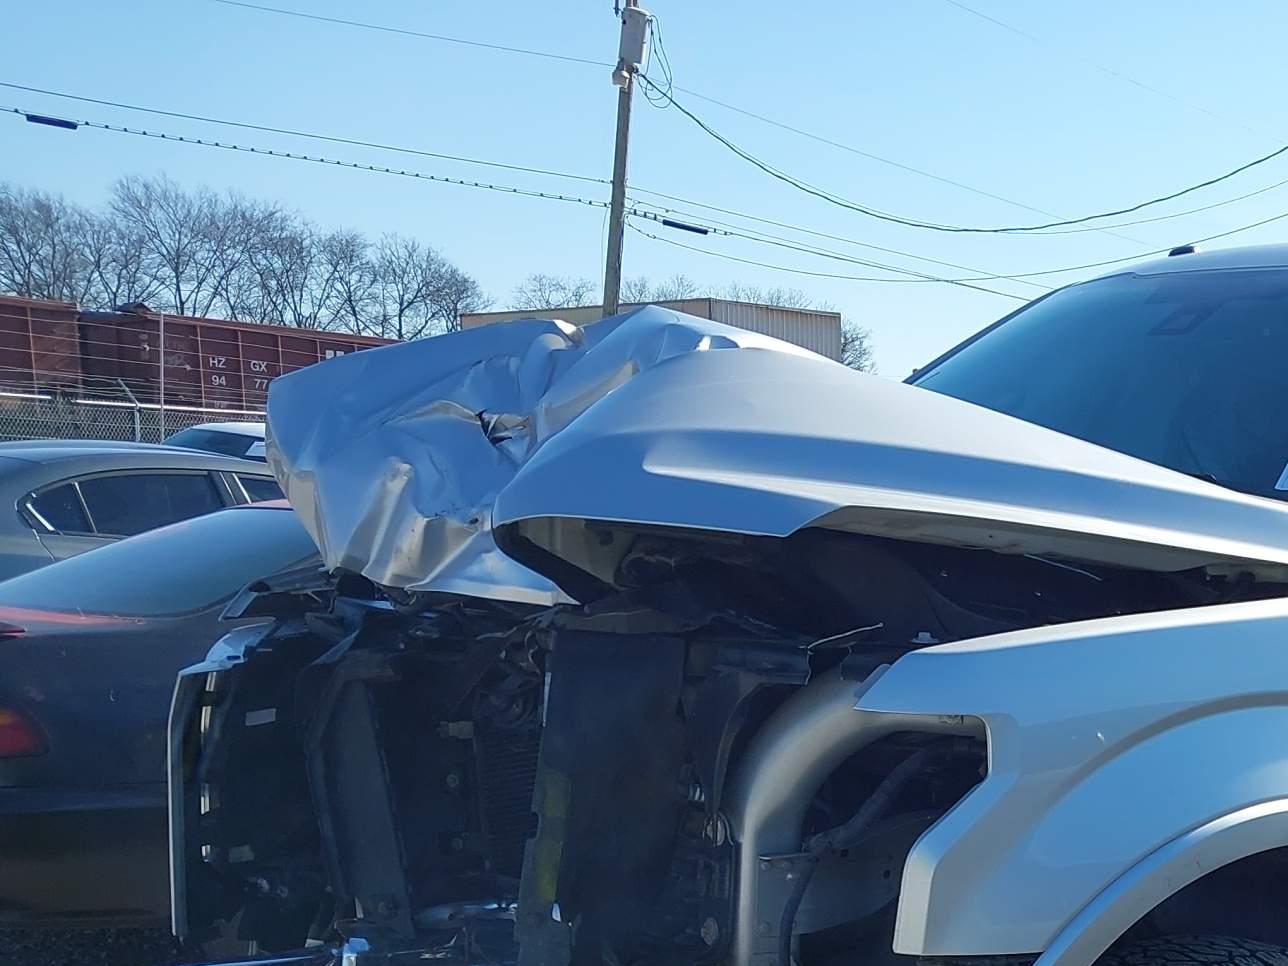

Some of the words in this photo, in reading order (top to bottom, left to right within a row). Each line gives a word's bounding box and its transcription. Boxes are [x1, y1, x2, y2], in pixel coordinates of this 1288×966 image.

[209, 356, 227, 369] HZ
[250, 361, 268, 373] GX
[211, 374, 227, 387] 94
